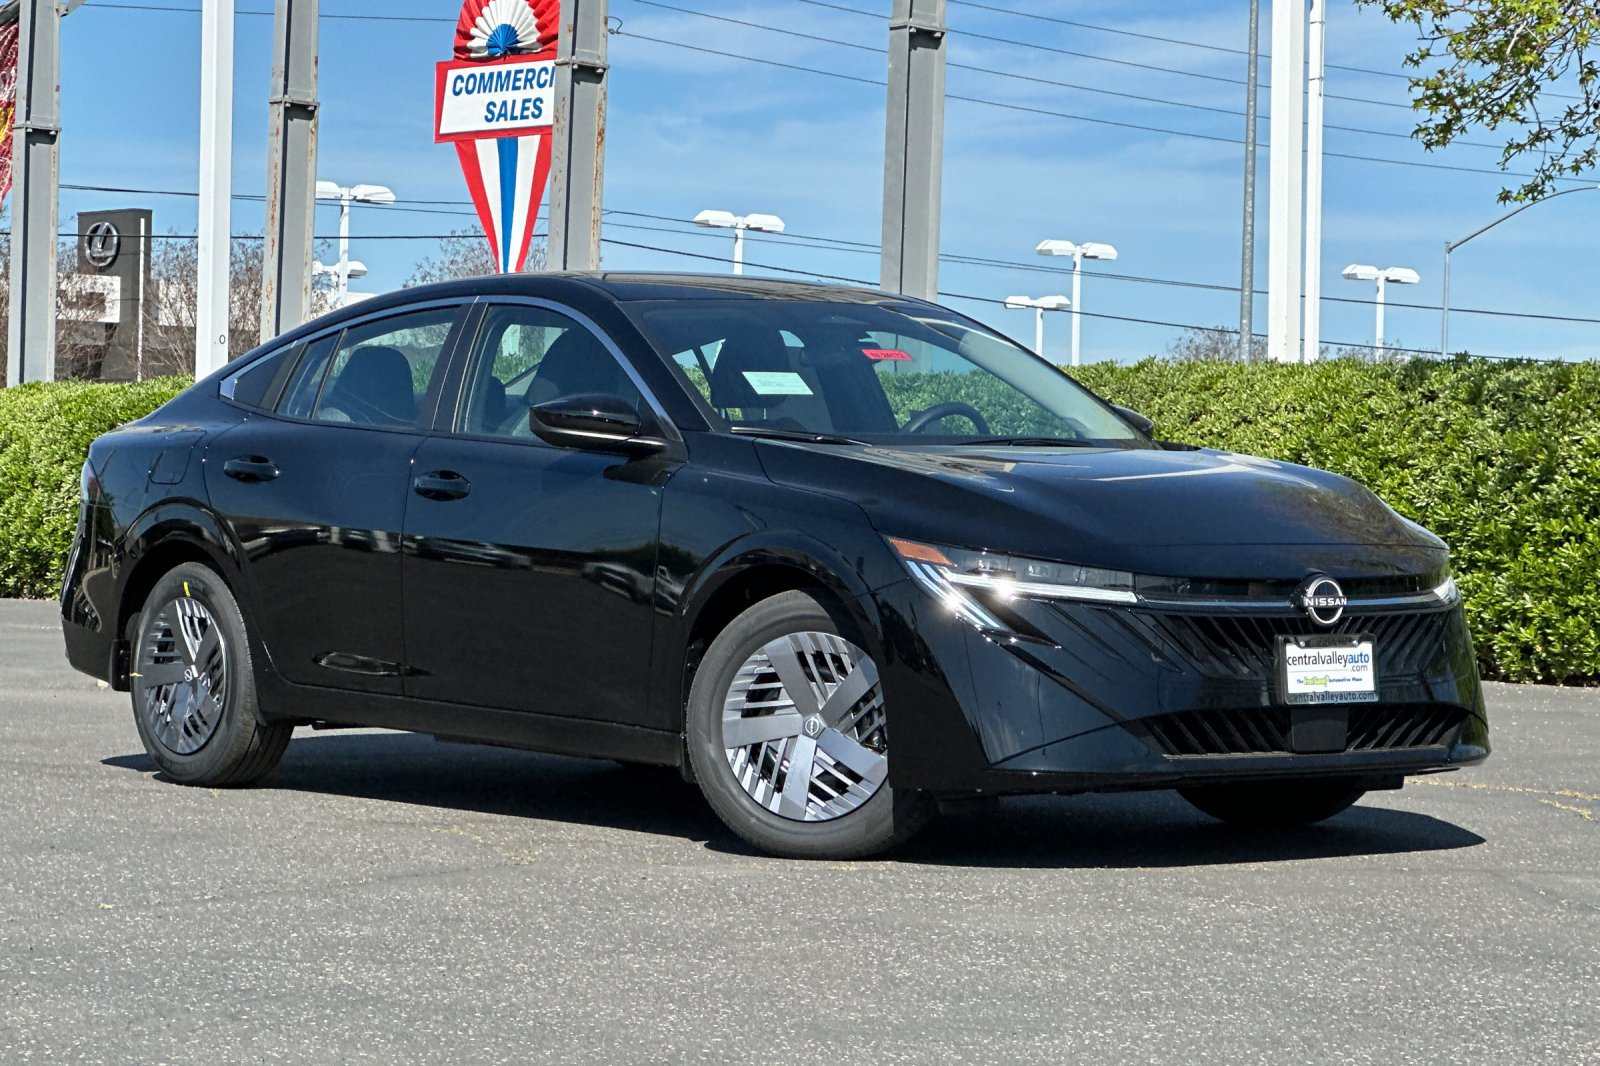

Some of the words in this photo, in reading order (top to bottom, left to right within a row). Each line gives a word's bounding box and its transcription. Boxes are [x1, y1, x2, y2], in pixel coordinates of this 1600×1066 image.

[484, 97, 544, 123] SALES
[1304, 597, 1347, 606] NISSAN
[1287, 651, 1370, 667] centralvalleyauto
[1350, 664, 1368, 672] .com
